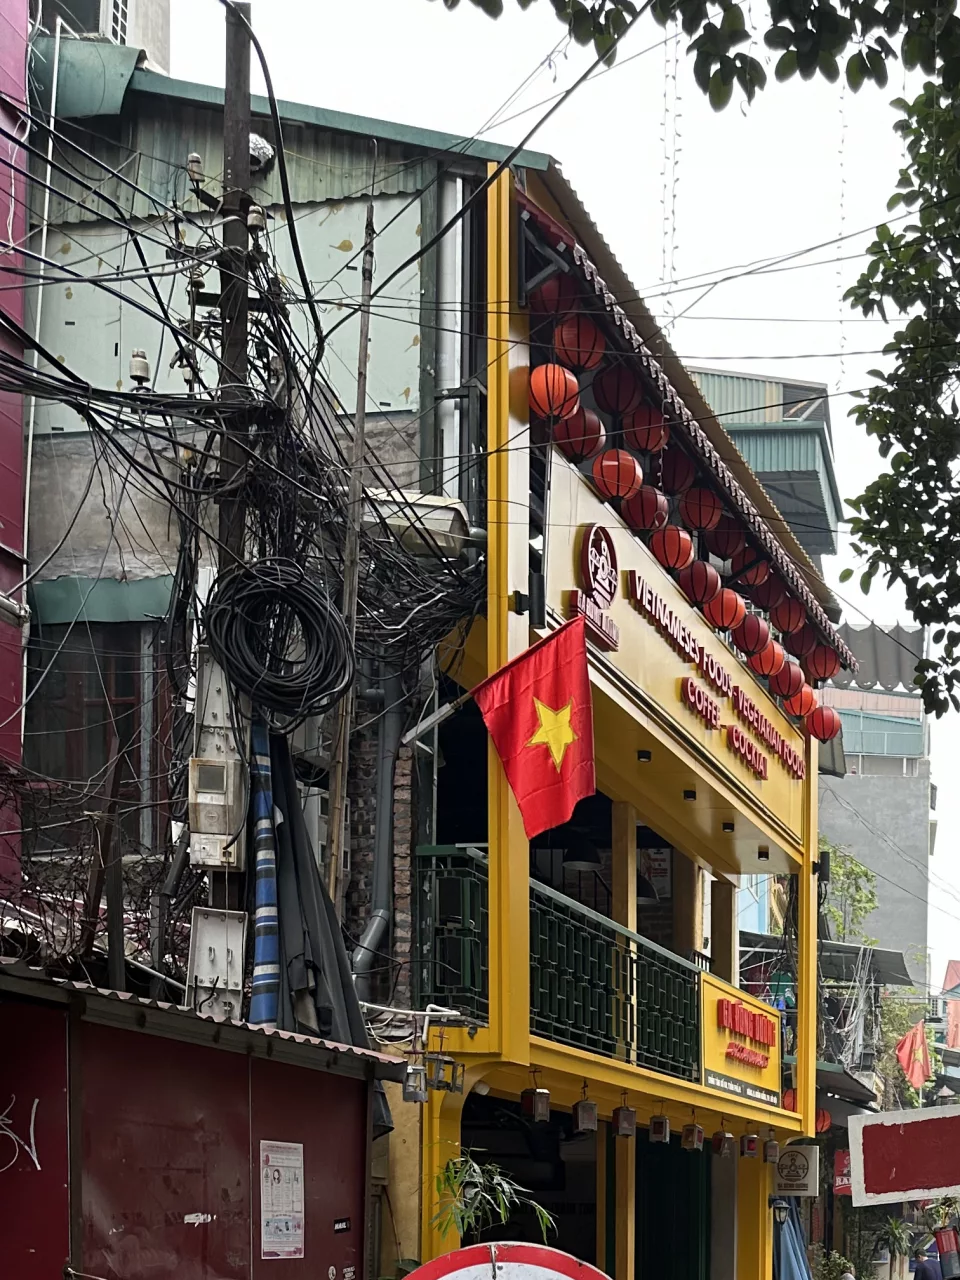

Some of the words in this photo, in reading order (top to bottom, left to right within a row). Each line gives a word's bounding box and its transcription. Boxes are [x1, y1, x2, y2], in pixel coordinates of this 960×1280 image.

[634, 573, 699, 663] VIETNAMESES
[702, 649, 732, 697] FOODS
[738, 689, 781, 754] VEGETARIAN
[686, 677, 720, 729] COFFEE
